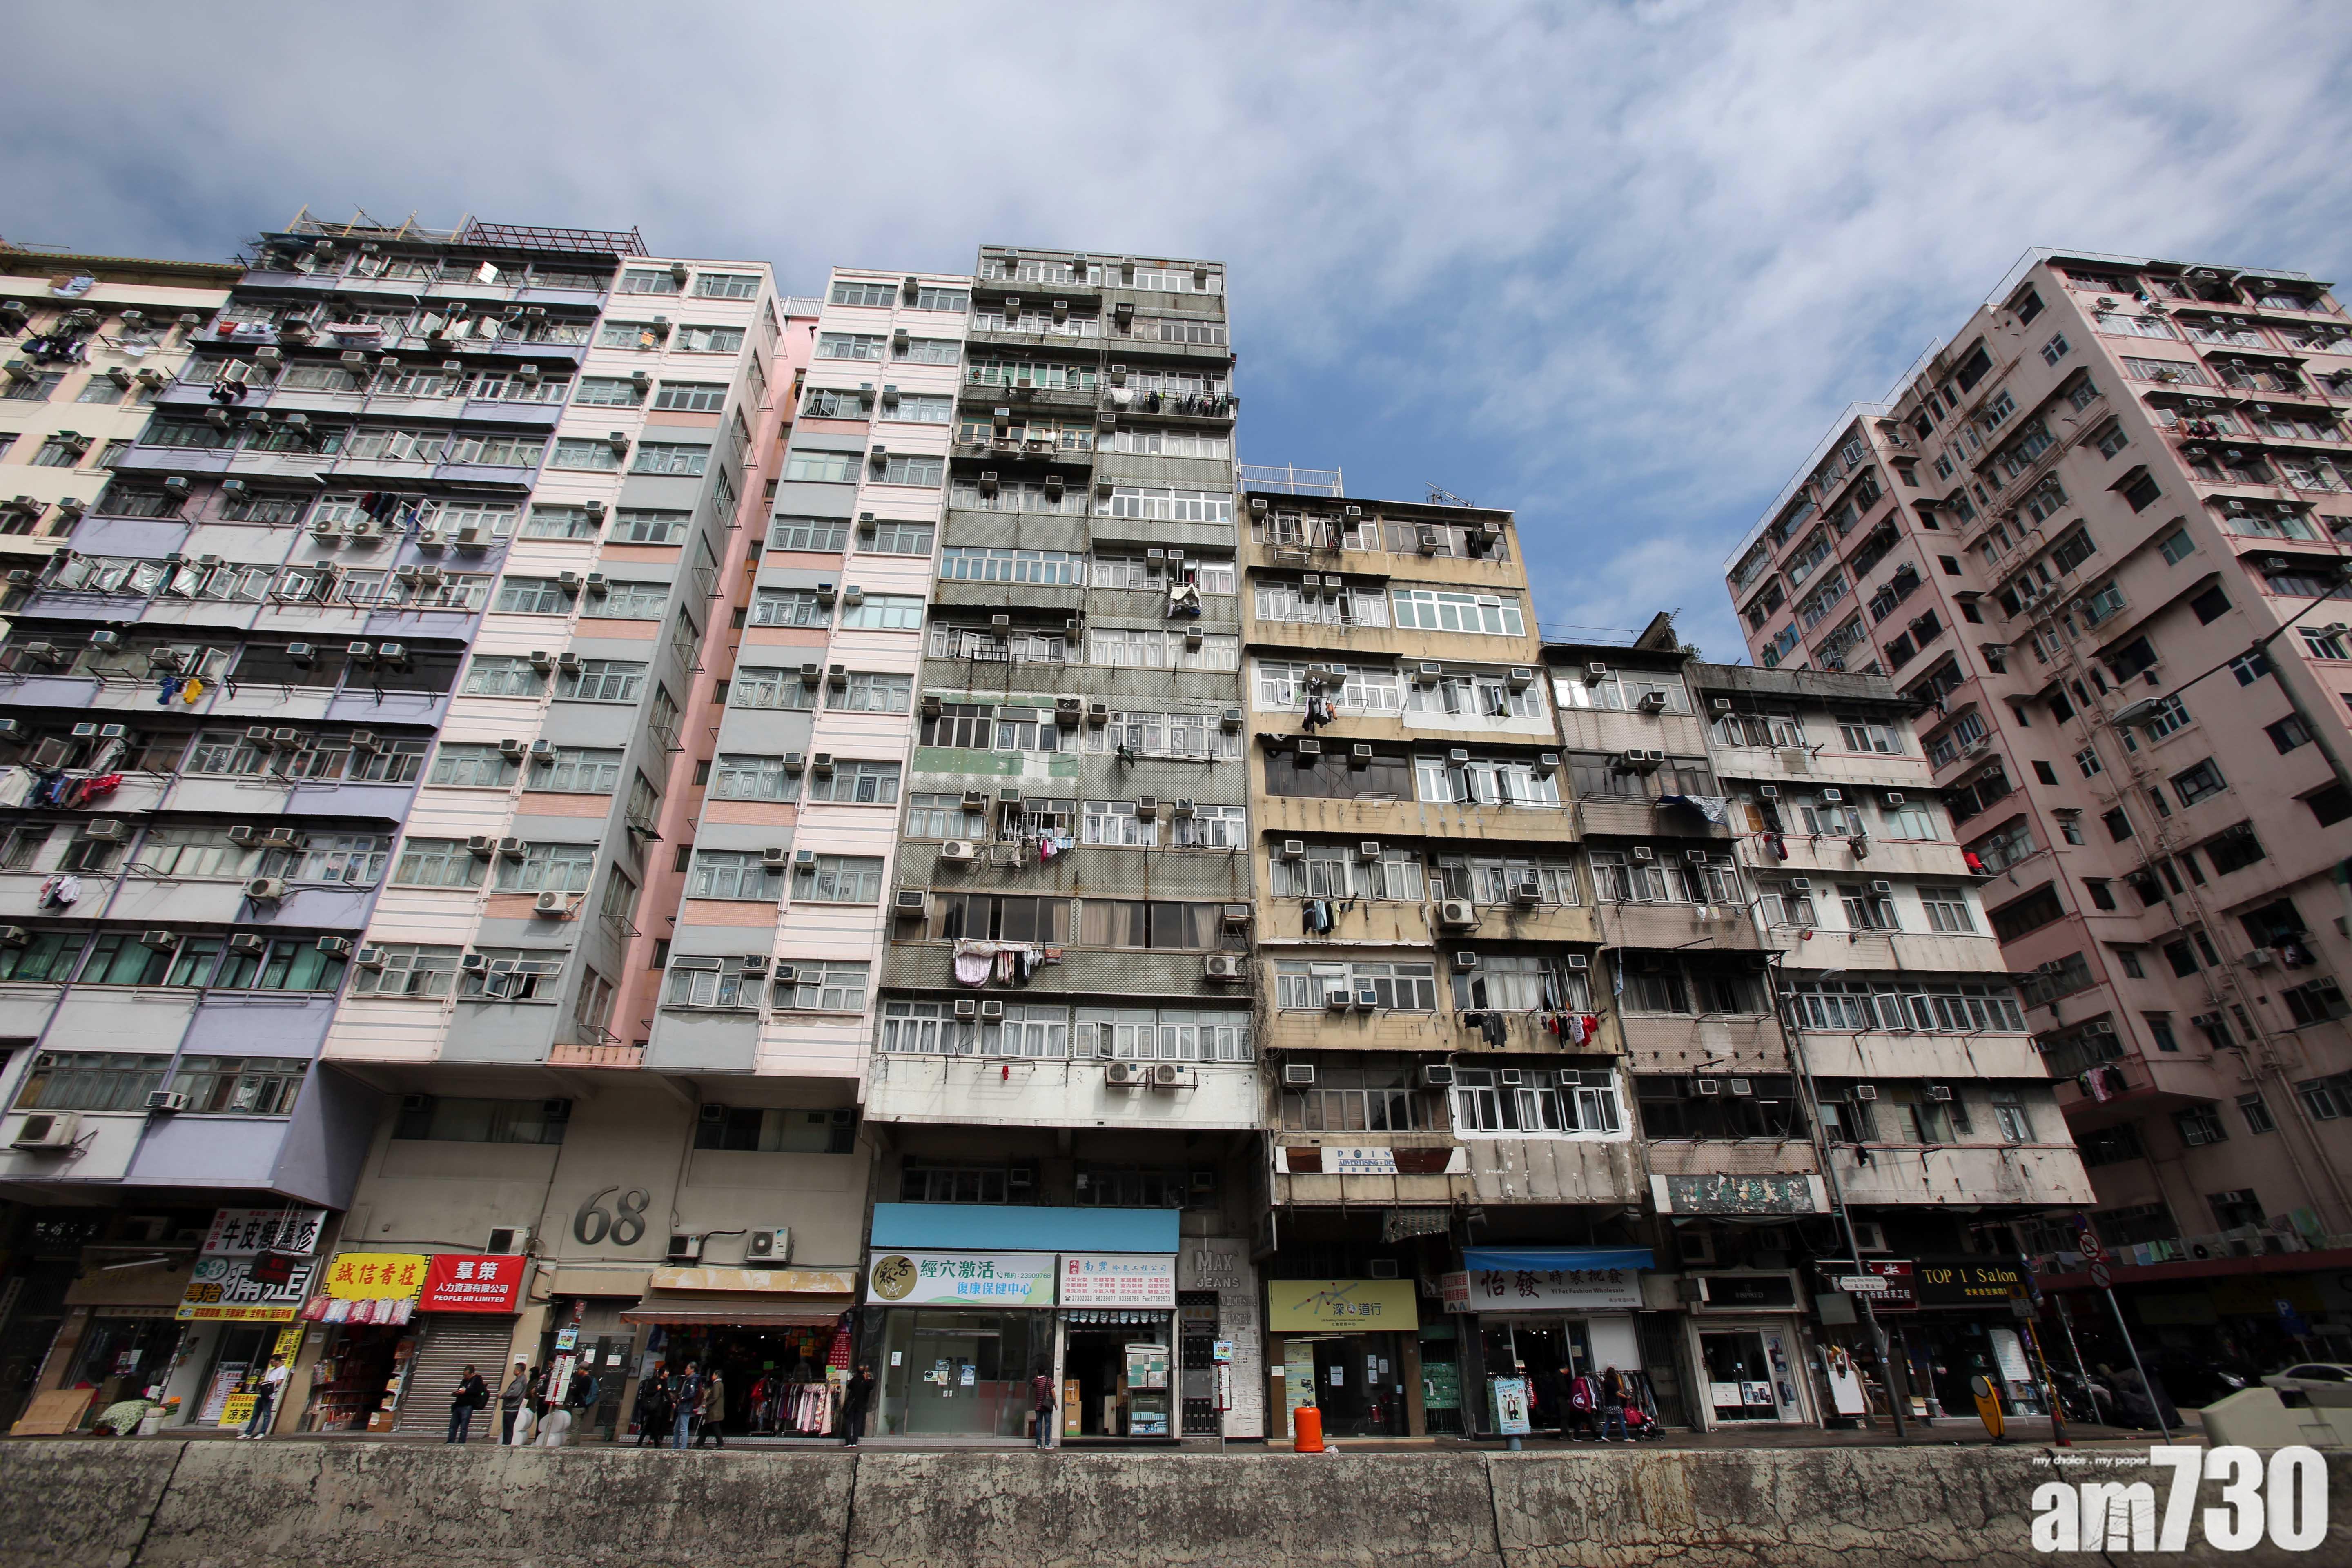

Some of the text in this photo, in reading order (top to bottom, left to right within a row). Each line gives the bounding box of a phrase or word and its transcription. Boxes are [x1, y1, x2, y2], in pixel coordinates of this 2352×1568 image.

[574, 1185, 650, 1246] 68
[335, 1262, 418, 1286] 誠信香莊
[920, 1259, 995, 1279] 經穴激活
[1921, 1269, 1952, 1283] TOP
[1976, 1267, 2019, 1283] Salon
[435, 1283, 509, 1294] 人力資源有限公司
[957, 1281, 1032, 1295] 復康保健中心
[1196, 1277, 1240, 1287] JEANS
[1481, 1268, 1624, 1298] 怡發 時裝批發
[184, 1282, 224, 1302] 專治
[2277, 1301, 2289, 1316] P
